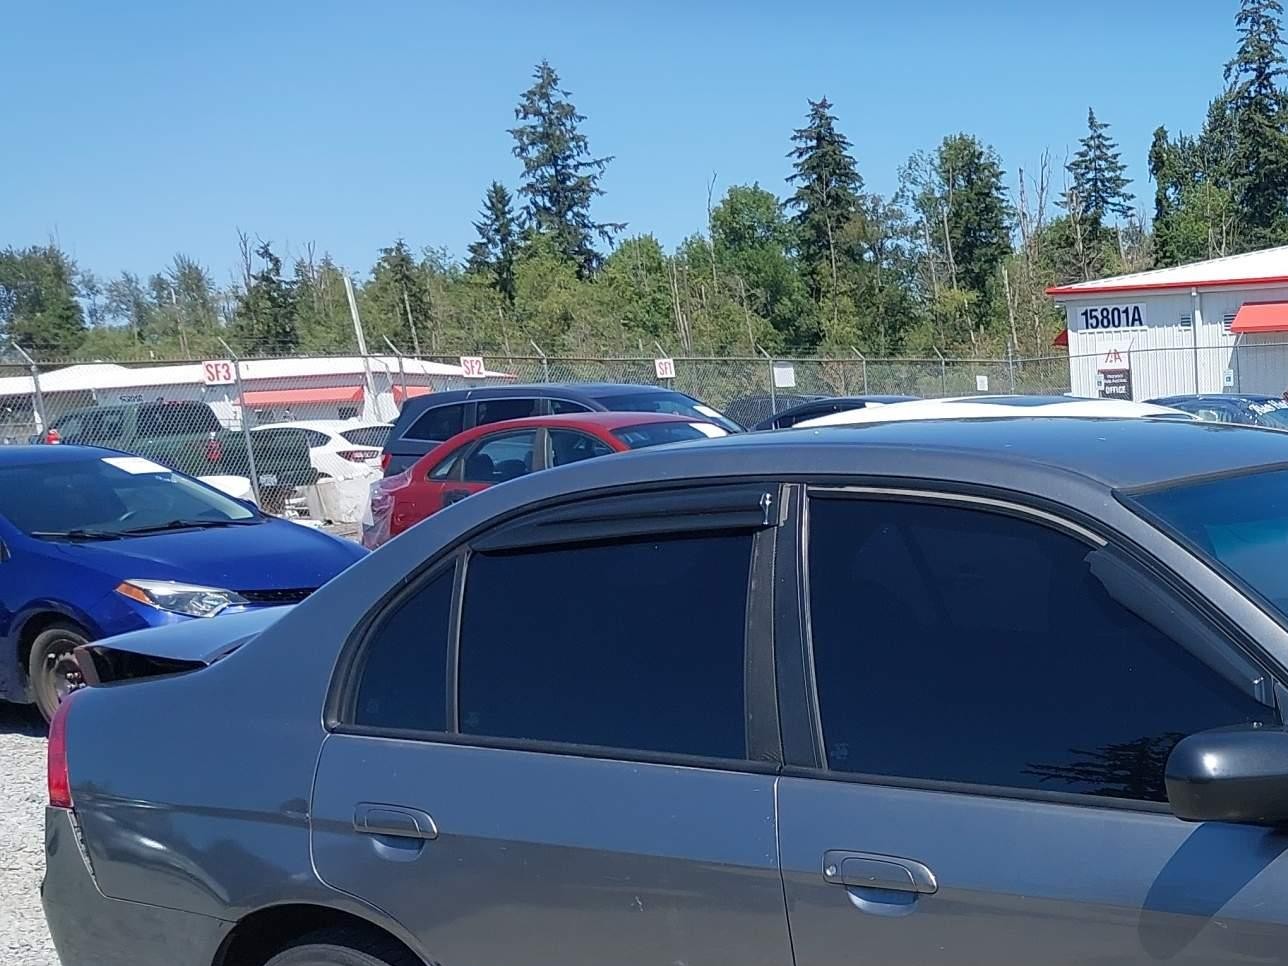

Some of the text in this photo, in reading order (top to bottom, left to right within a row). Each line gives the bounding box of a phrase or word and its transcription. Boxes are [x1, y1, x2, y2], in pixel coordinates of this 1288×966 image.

[1080, 305, 1144, 330] 15801A
[205, 363, 231, 382] SF3
[463, 359, 483, 375] SF2
[658, 361, 673, 376] SF1
